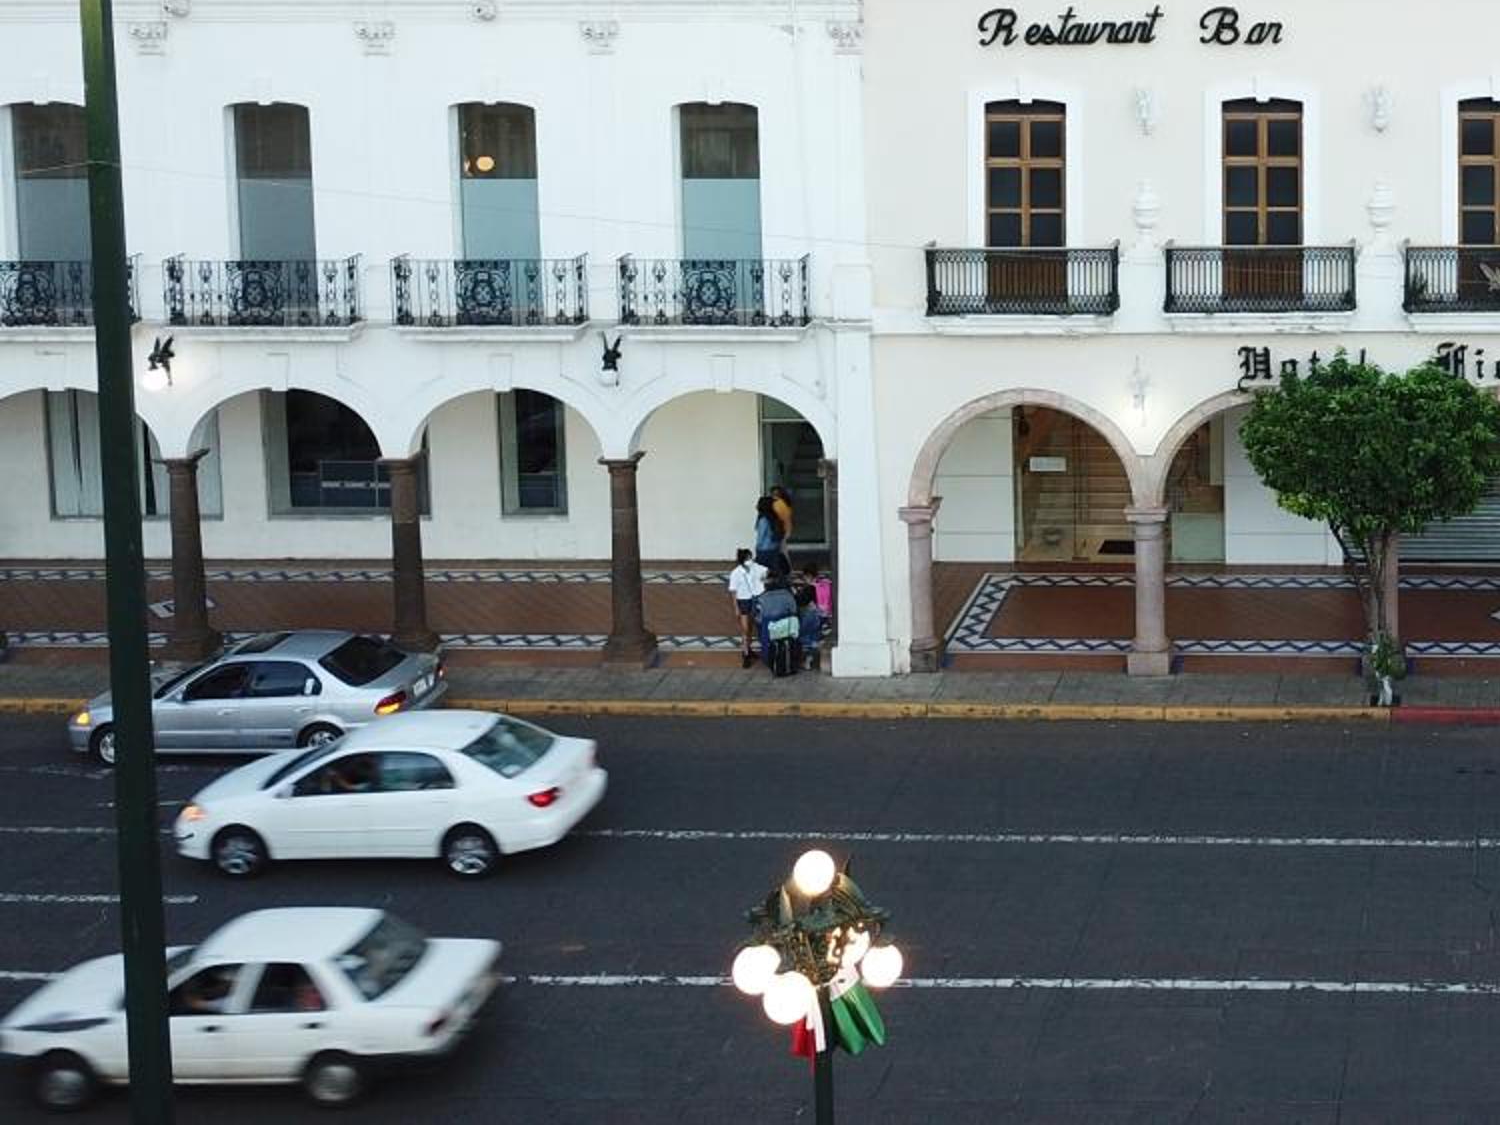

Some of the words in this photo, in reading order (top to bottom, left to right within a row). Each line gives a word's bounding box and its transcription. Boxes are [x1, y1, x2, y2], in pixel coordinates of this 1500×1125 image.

[977, 5, 1164, 47] Restaurant
[1199, 6, 1283, 46] Bar
[1237, 345, 1368, 393] Hotl
